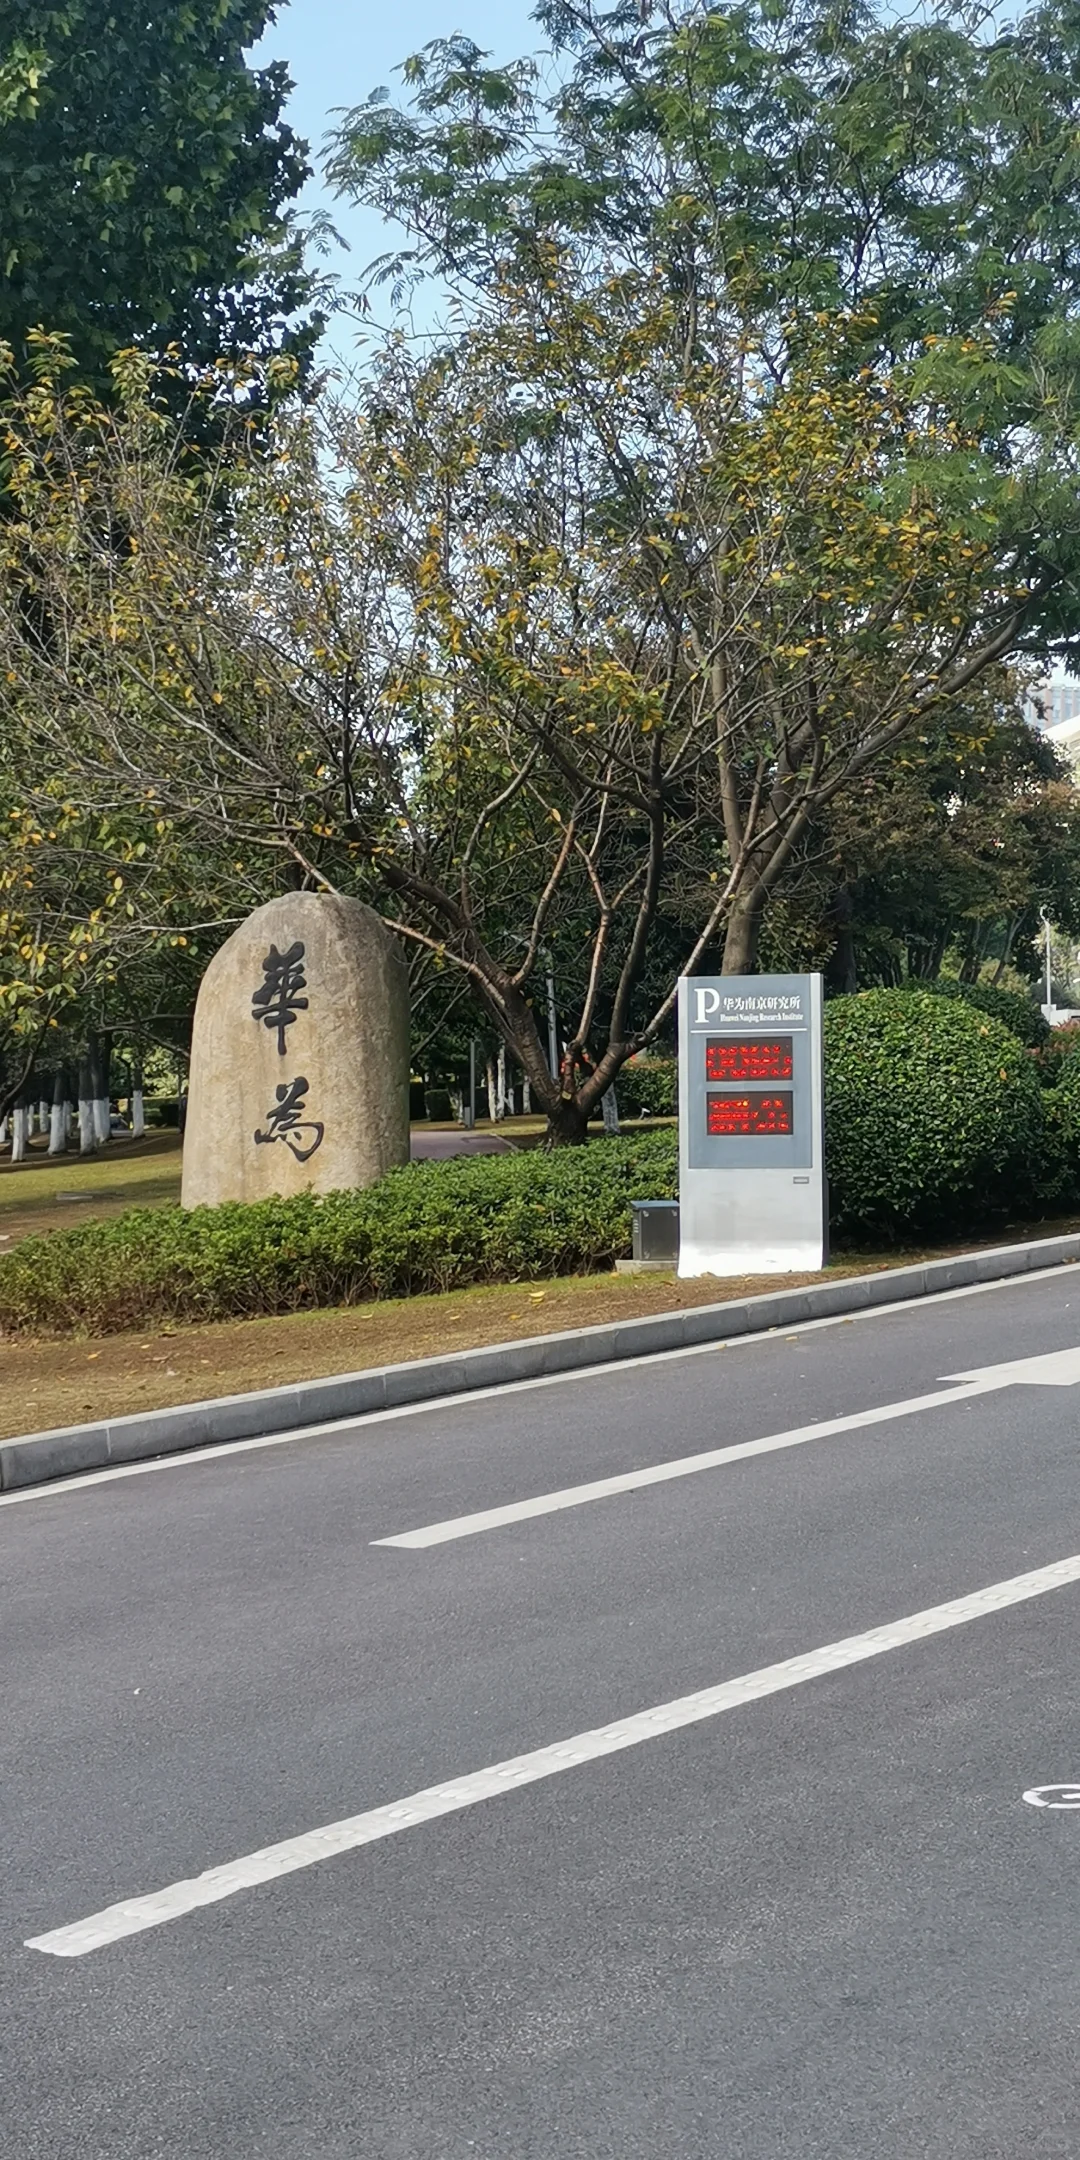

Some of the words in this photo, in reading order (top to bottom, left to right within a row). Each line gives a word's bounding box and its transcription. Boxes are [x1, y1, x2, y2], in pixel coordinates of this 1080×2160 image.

[694, 988, 720, 1023] P
[723, 996, 800, 1010] 华为南京研究所
[759, 1012, 782, 1022] Research
